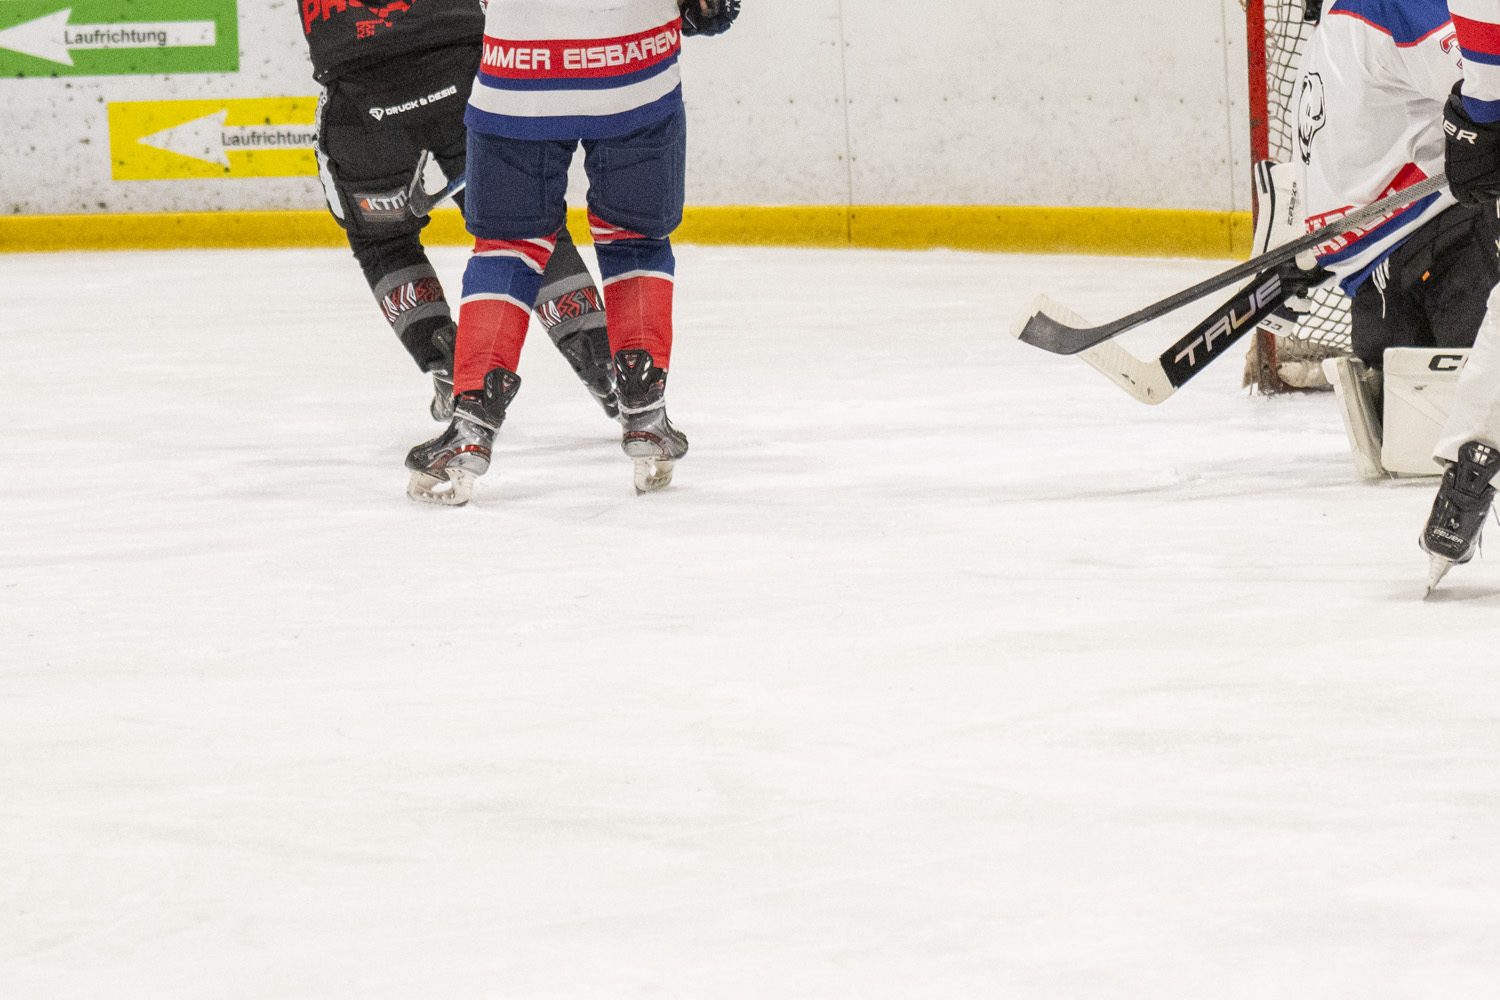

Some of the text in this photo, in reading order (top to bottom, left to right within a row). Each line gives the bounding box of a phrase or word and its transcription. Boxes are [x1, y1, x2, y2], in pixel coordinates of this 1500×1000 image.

[64, 29, 167, 47] Laufrichtung
[482, 28, 678, 71] MMER EISBÄREN
[385, 100, 419, 116] DRUCK
[428, 85, 457, 103] DESIG
[221, 130, 313, 147] Laufrichtun
[1174, 273, 1283, 367] TRUE
